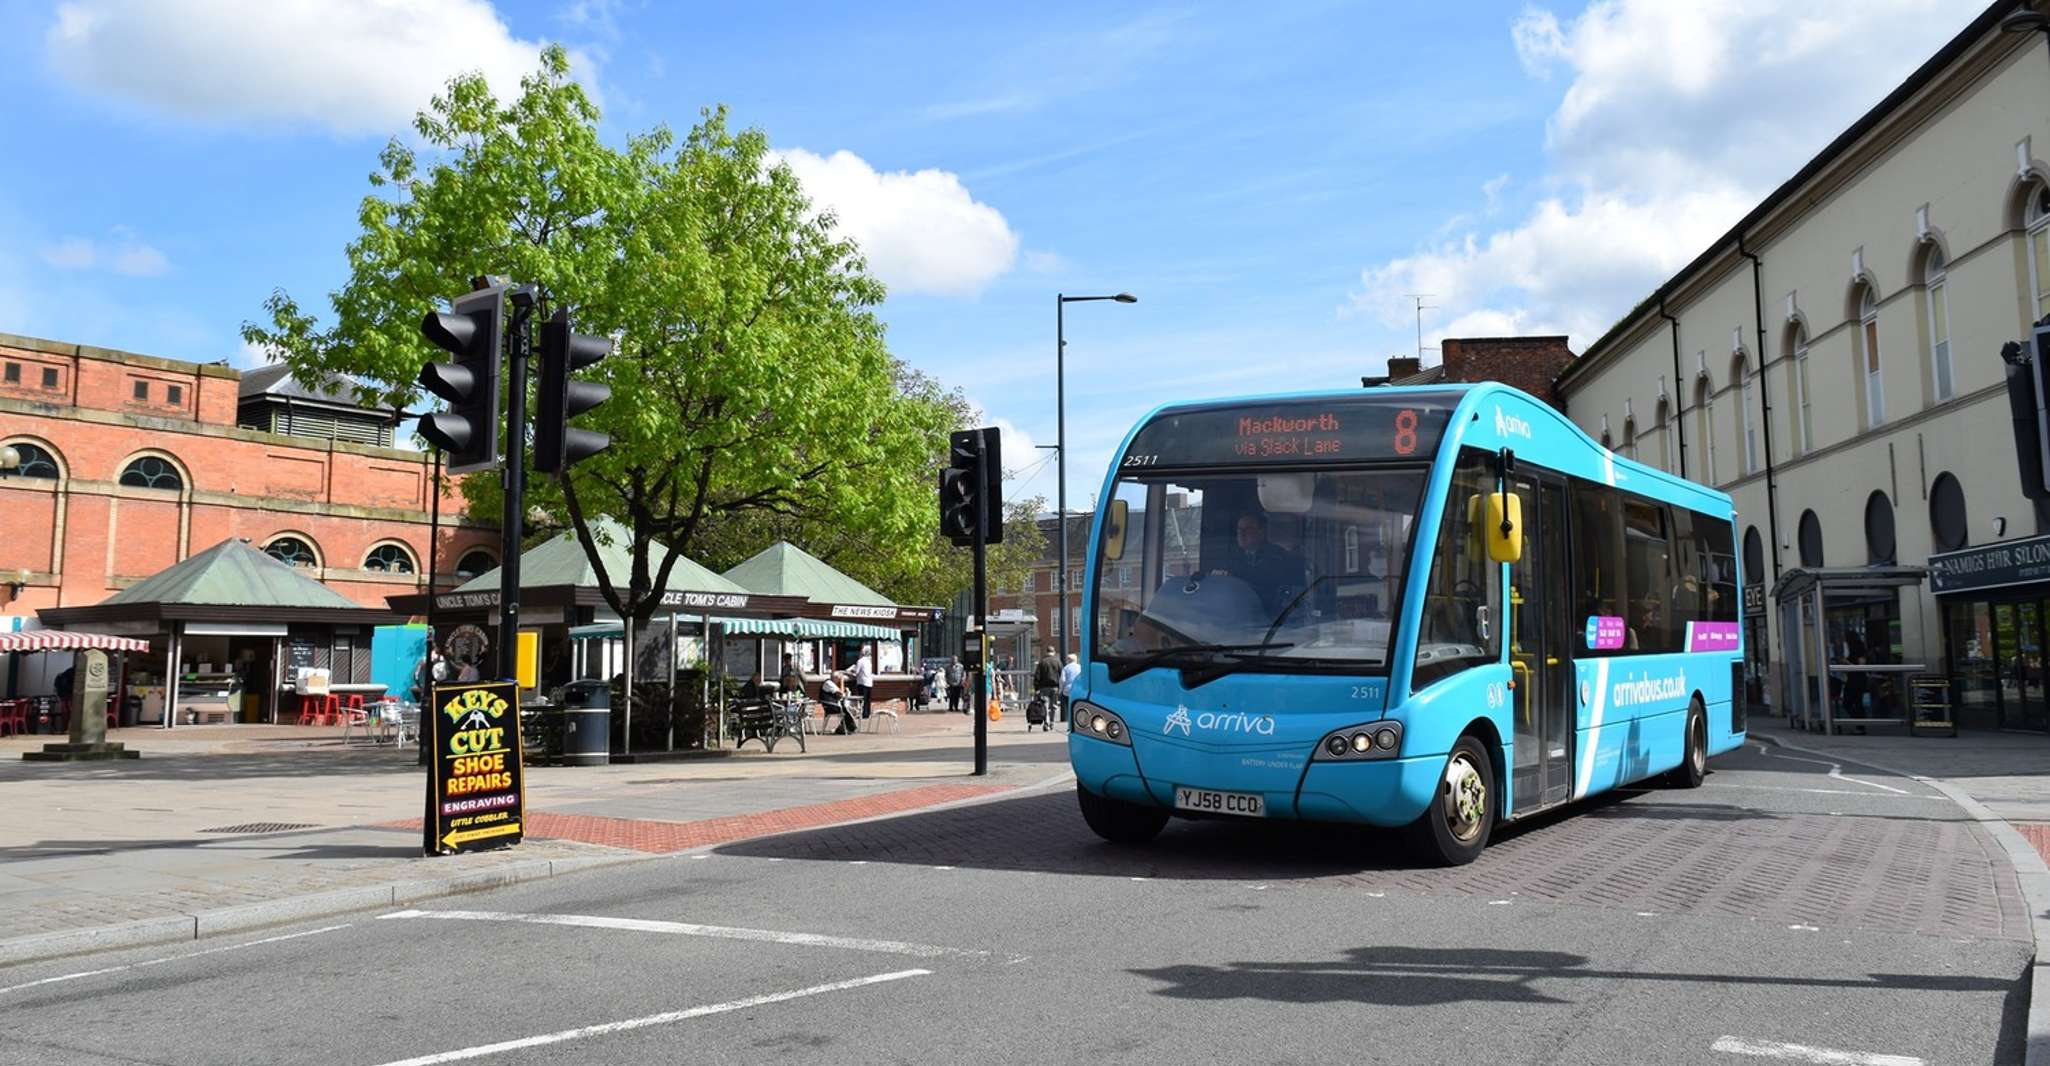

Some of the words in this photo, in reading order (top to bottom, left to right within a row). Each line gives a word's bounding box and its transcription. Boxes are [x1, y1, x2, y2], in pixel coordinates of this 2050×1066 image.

[1239, 413, 1339, 436] Mackworth
[1394, 409, 1417, 455] 8
[1234, 442, 1257, 456] via
[1261, 437, 1299, 457] Slack
[1304, 438, 1341, 456] Lane
[1124, 455, 1158, 466] 2511
[436, 595, 464, 609] UNCLE
[464, 592, 491, 606] TOM'S
[660, 592, 682, 605] CLE
[683, 593, 715, 607] TOM'S
[716, 595, 749, 609] CABIN
[1745, 587, 1762, 607] EYE
[834, 607, 848, 616] THE
[850, 608, 871, 616] NEWS
[873, 608, 895, 617] KIOSK
[1351, 687, 1379, 699] 2511
[1613, 666, 1687, 708] arrivabus.co.uk
[444, 690, 509, 724] KEYS
[1197, 711, 1276, 736] arriva
[450, 727, 504, 755] CUT
[453, 754, 505, 776] SHOE
[447, 771, 513, 795] REPAIRS
[444, 794, 515, 813] ENGRAVING
[1181, 789, 1223, 810] YJ58
[1226, 794, 1258, 813] CCO
[450, 817, 474, 828] LITTLE
